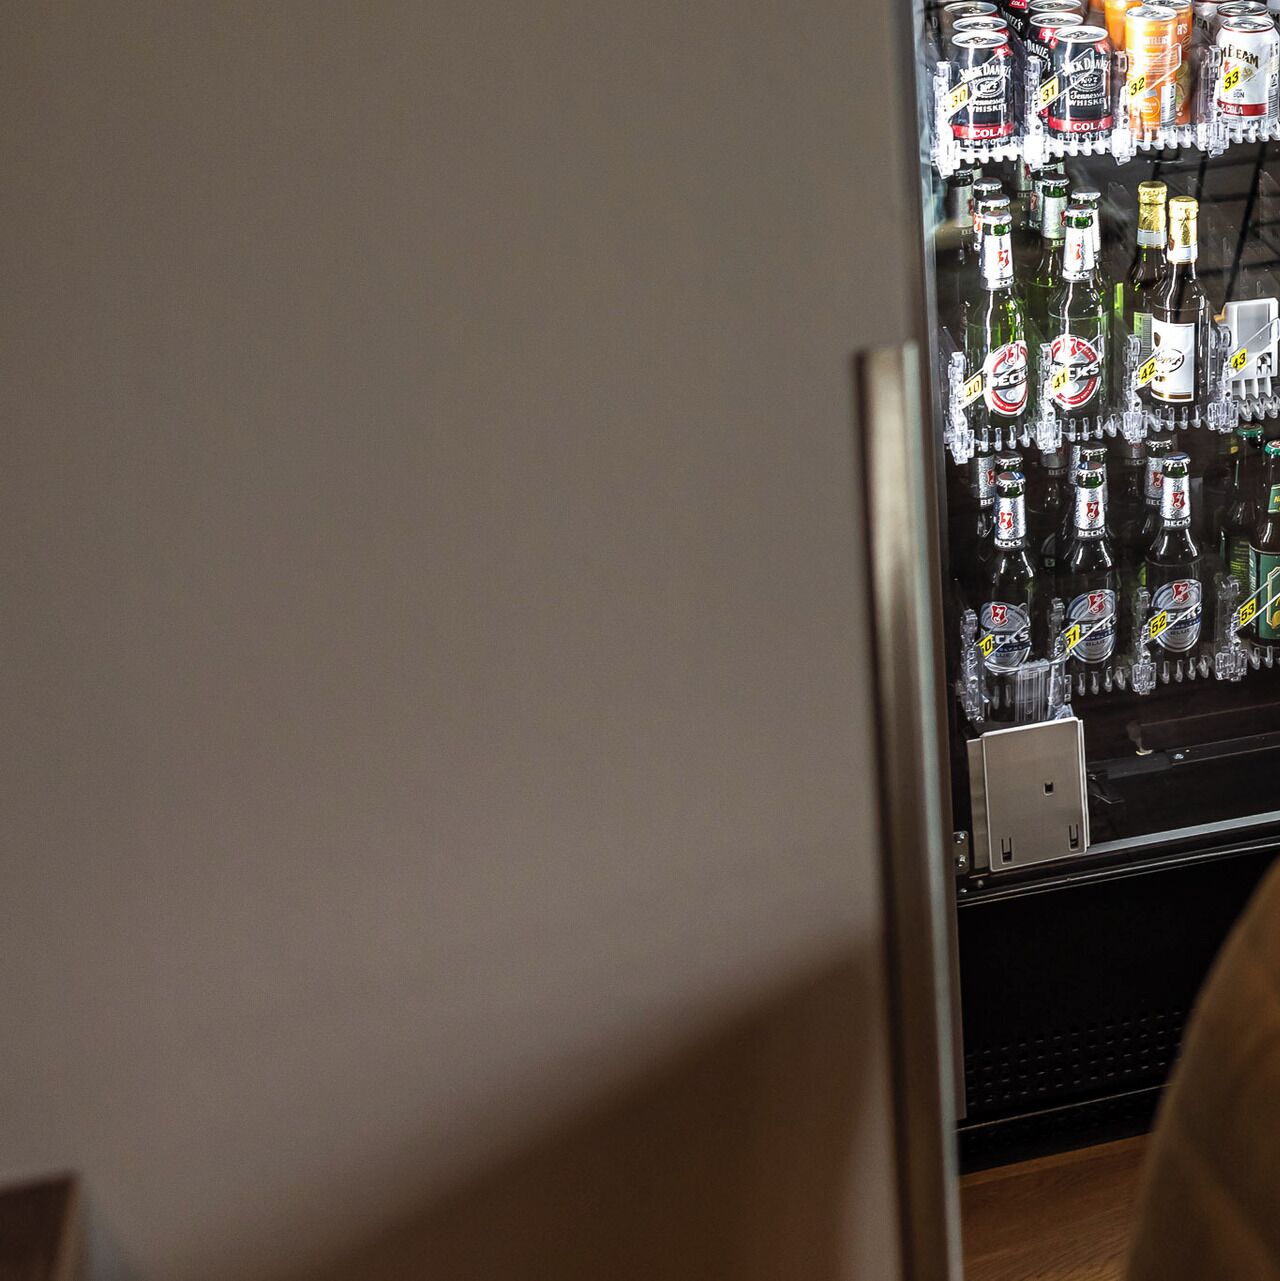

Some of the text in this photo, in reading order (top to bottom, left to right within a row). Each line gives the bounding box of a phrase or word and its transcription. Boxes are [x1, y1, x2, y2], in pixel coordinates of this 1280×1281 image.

[1130, 77, 1145, 95] 32
[1224, 70, 1239, 89] 33
[1042, 84, 1056, 101] 31
[974, 128, 1004, 138] COLA
[1073, 122, 1105, 131] COLA
[1232, 352, 1246, 368] 43
[1140, 362, 1155, 380] 42
[1241, 604, 1255, 620] 53
[1152, 616, 1166, 633] 52
